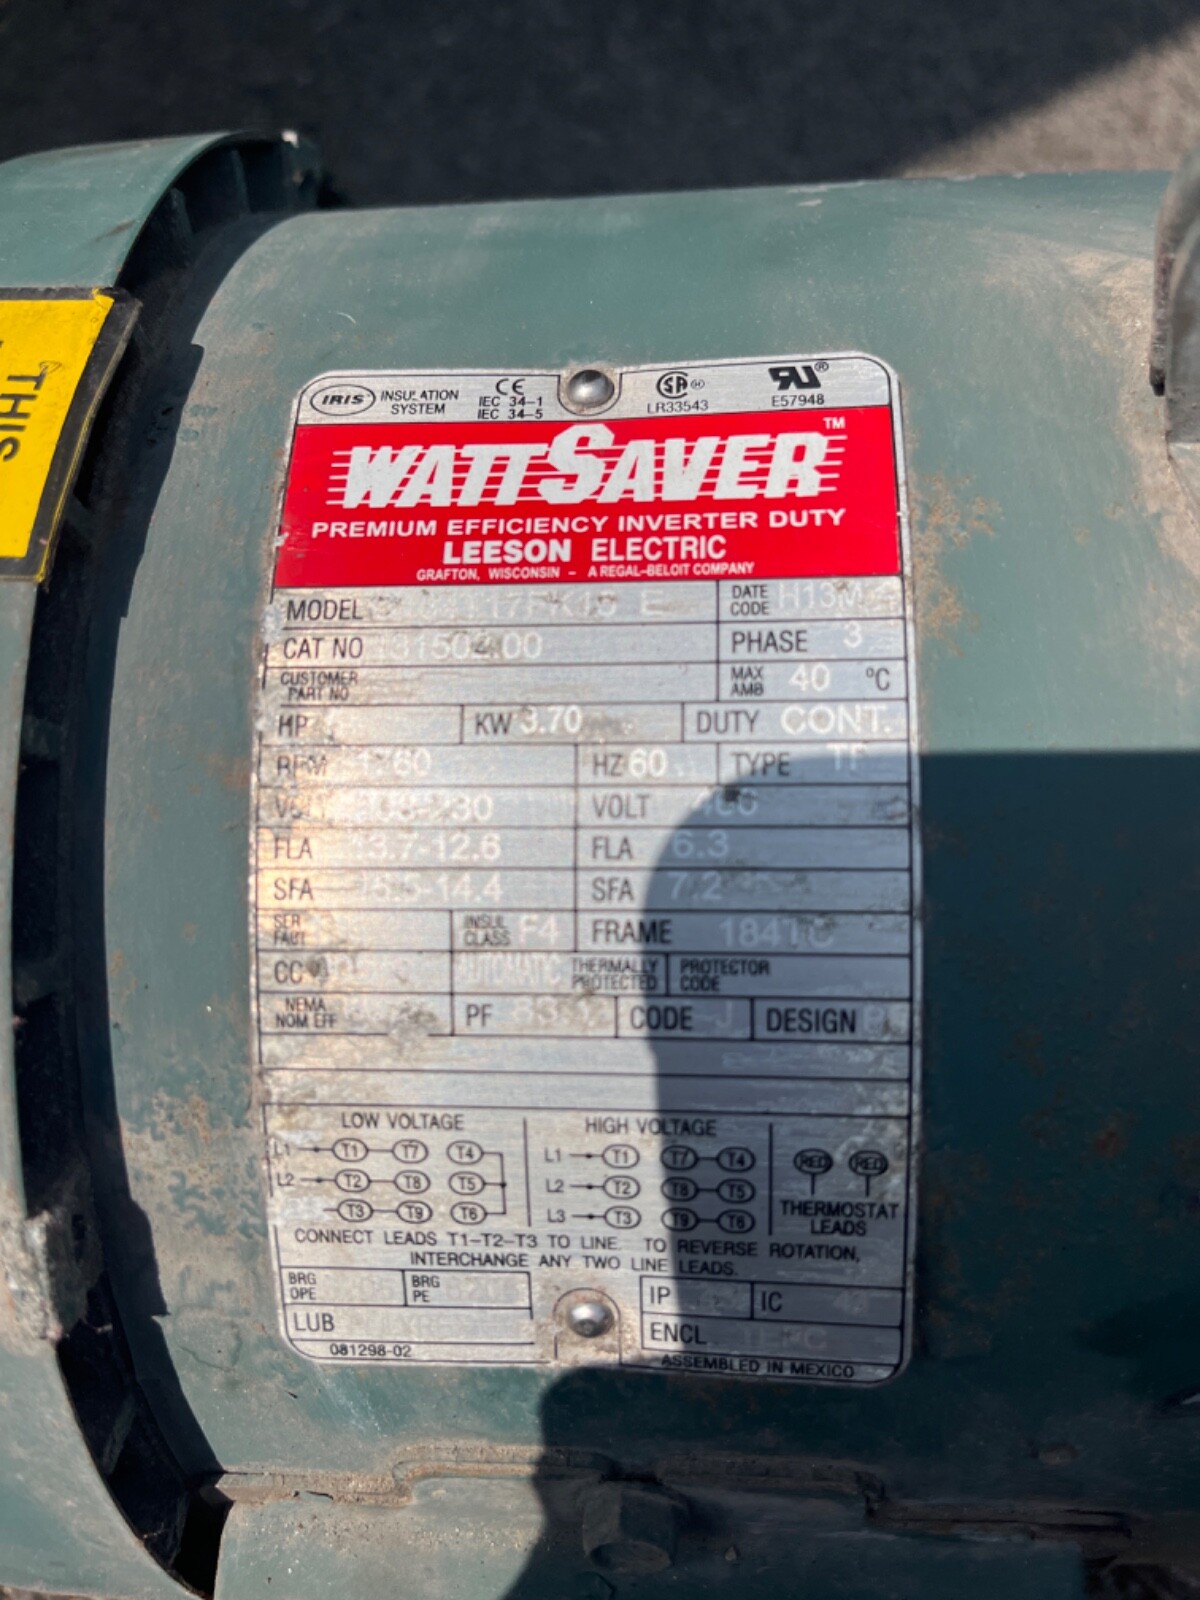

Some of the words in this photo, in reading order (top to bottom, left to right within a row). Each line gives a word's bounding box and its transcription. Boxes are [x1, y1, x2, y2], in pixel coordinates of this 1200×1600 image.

[321, 394, 365, 406] IRIS
[381, 390, 459, 402] INSULATION
[478, 397, 500, 407] IEC
[509, 396, 543, 407] 34-1
[771, 394, 825, 407] E57948
[0, 366, 47, 461] THIS
[390, 403, 446, 415] SYSTEM
[477, 409, 500, 420] IEC
[507, 408, 544, 420] 34-5
[646, 400, 709, 414] LR33543
[312, 520, 437, 539] PREMIUM
[446, 515, 609, 536] EFFICIENCY
[618, 511, 758, 533] INVERTER
[769, 508, 846, 528] DUTY
[442, 539, 572, 565] LEESON
[591, 535, 727, 562] ELECTRIC
[416, 567, 481, 582] GRAFTON,
[488, 566, 561, 579] WISCONSIN
[587, 565, 598, 578] A
[600, 563, 690, 578] REGAL-BELOIT
[692, 562, 755, 576] COMPANY
[731, 584, 768, 599] DATE
[286, 599, 363, 621] MODEL
[730, 601, 770, 617] CODE
[731, 629, 808, 654] PHASE
[843, 619, 863, 649] 3
[283, 637, 324, 660] CAT
[332, 637, 364, 659] NO
[280, 671, 358, 686] CUSTOMER
[730, 666, 764, 680] MAX
[788, 662, 831, 692] 40
[288, 687, 327, 701] PART
[330, 687, 350, 701] NO
[730, 682, 765, 697] AMB
[278, 714, 309, 738] HP
[475, 712, 512, 736] KW
[520, 705, 582, 734] 3.70
[696, 710, 760, 735] DUTY
[780, 704, 892, 735] CONT.
[592, 753, 623, 777] HZ
[628, 748, 668, 778] 60
[730, 752, 790, 777] TYPE
[592, 794, 650, 819] VOLT
[273, 836, 313, 860] FLA
[591, 836, 634, 860] FLA
[672, 829, 729, 859] 6.3
[273, 877, 314, 901] SFA
[591, 877, 635, 901] SFA
[667, 870, 723, 900] 7.2
[464, 914, 507, 929] INSUL
[463, 931, 511, 947] CLASS
[592, 918, 673, 945] FRAME
[274, 960, 303, 984] CC
[571, 957, 660, 973] THERMALLY
[679, 958, 771, 976] PROTECTOR
[571, 974, 658, 991] PROTECTED
[679, 975, 720, 992] CODE
[285, 996, 326, 1012] NEMA
[275, 1013, 309, 1029] NOM
[314, 1013, 337, 1028] EFF
[465, 1003, 493, 1028] PF
[630, 1005, 694, 1031] CODE
[766, 1007, 856, 1034] DESIGN
[341, 1112, 380, 1129] LOW
[386, 1113, 465, 1131] VOLTAGE
[585, 1118, 628, 1134] HIGH
[636, 1119, 717, 1137] VOLTAGE
[274, 1143, 291, 1156] L1
[341, 1144, 358, 1157] T1
[400, 1145, 419, 1158] T7
[455, 1146, 474, 1160] T4
[544, 1148, 562, 1162] L1
[611, 1151, 629, 1164] T1
[669, 1152, 688, 1165] T7
[727, 1154, 745, 1167] T4
[800, 1155, 829, 1169] RED
[854, 1157, 884, 1171] RED
[277, 1173, 295, 1187] L2
[343, 1175, 362, 1188] T2
[402, 1176, 422, 1190] T8
[457, 1177, 476, 1191] T5
[546, 1179, 565, 1193] L2
[613, 1181, 632, 1195] T2
[670, 1182, 689, 1195] T8
[727, 1184, 746, 1197] T5
[345, 1205, 365, 1218] T3
[405, 1206, 424, 1220] T9
[459, 1207, 478, 1221] T6
[547, 1209, 566, 1223] L3
[614, 1212, 633, 1225] T3
[671, 1213, 689, 1227] T9
[727, 1215, 746, 1229] T6
[780, 1200, 899, 1220] THERMOSTAT
[810, 1220, 867, 1236] LEADS
[294, 1229, 374, 1244] CONNECT
[383, 1230, 438, 1247] LEADS
[449, 1232, 538, 1249] T1-T2-T3
[547, 1234, 571, 1249] TO
[644, 1237, 667, 1254] TO
[677, 1239, 758, 1258] REVERSE
[769, 1242, 860, 1263] ROTATION,
[410, 1252, 529, 1268] INTERCHANGE
[538, 1254, 572, 1269] ANY
[581, 1256, 622, 1270] TWO
[631, 1258, 669, 1273] LINE
[678, 1260, 739, 1277] LEADS.
[288, 1272, 317, 1285] BRG
[411, 1275, 440, 1289] BRG
[290, 1287, 317, 1300] OPE
[412, 1291, 429, 1303] PE
[649, 1286, 671, 1305] IP
[761, 1291, 783, 1313] IC
[293, 1312, 336, 1333] LUB
[650, 1324, 707, 1345] ENCL
[329, 1343, 412, 1358] 081298-02
[661, 1354, 759, 1374] ASSEMBLED
[767, 1360, 784, 1375] IN
[790, 1362, 855, 1379] MEXICO
